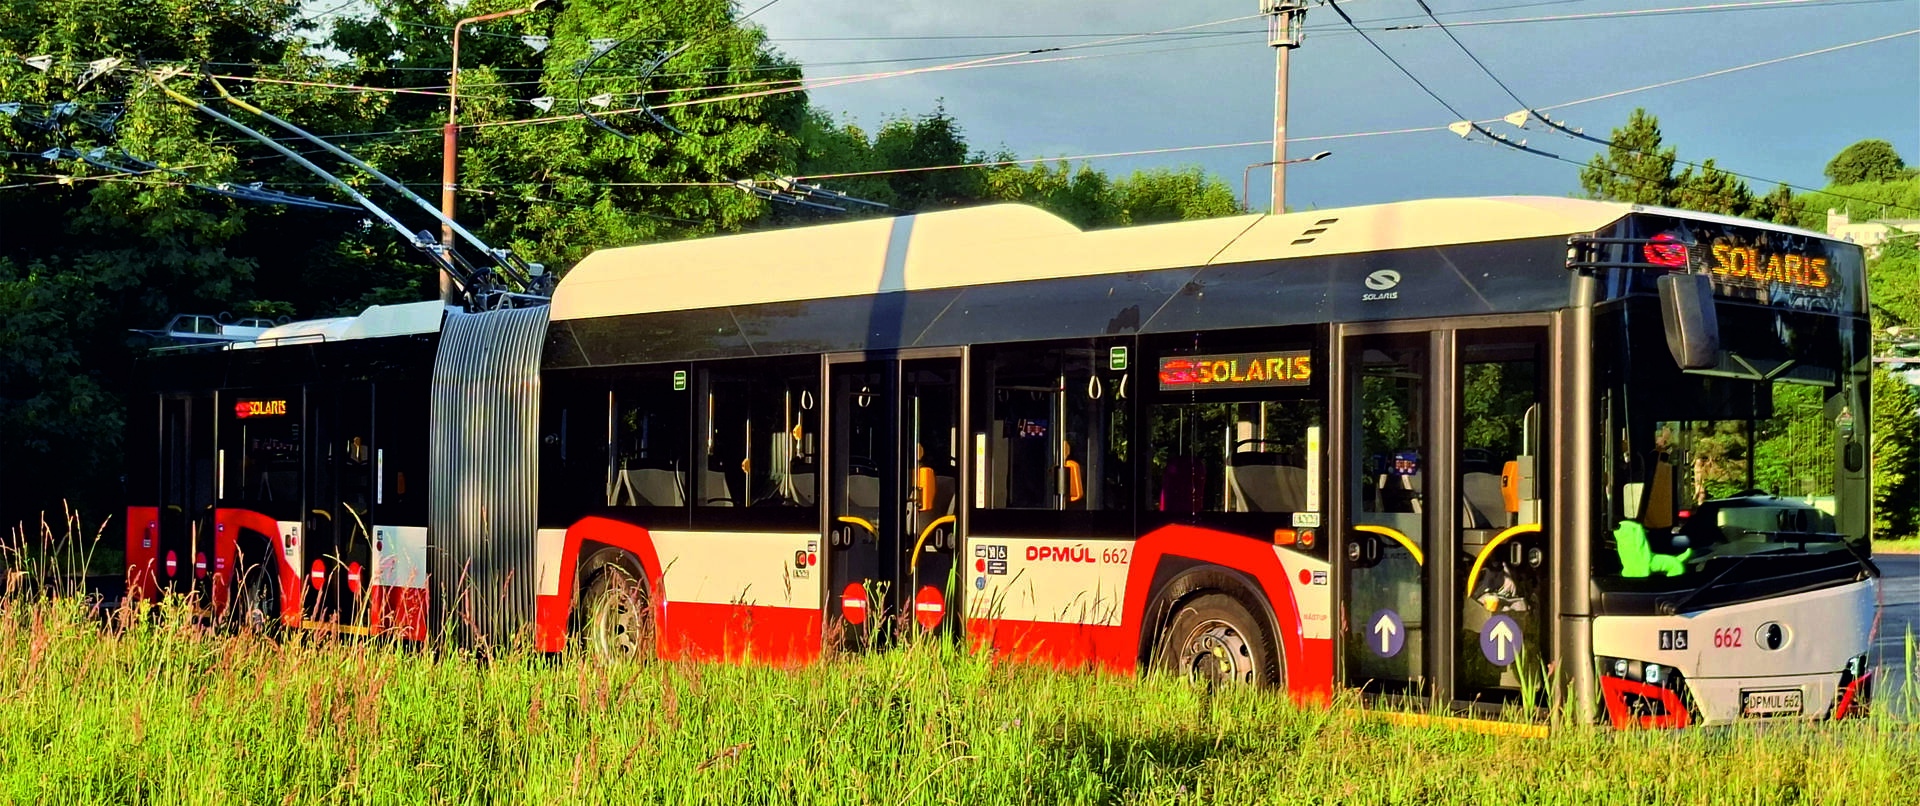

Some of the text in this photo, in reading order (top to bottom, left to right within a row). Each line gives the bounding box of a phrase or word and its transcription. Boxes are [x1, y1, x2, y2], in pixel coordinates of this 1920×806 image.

[1712, 243, 1829, 288] SOLARIS
[1362, 291, 1398, 301] SOLARIS
[1196, 356, 1311, 384] SOLARIS
[248, 400, 287, 415] SOLARIS
[1026, 544, 1129, 564] DPMÚL 662
[1713, 626, 1742, 648] 662
[1749, 695, 1800, 709] DPMUL 662
